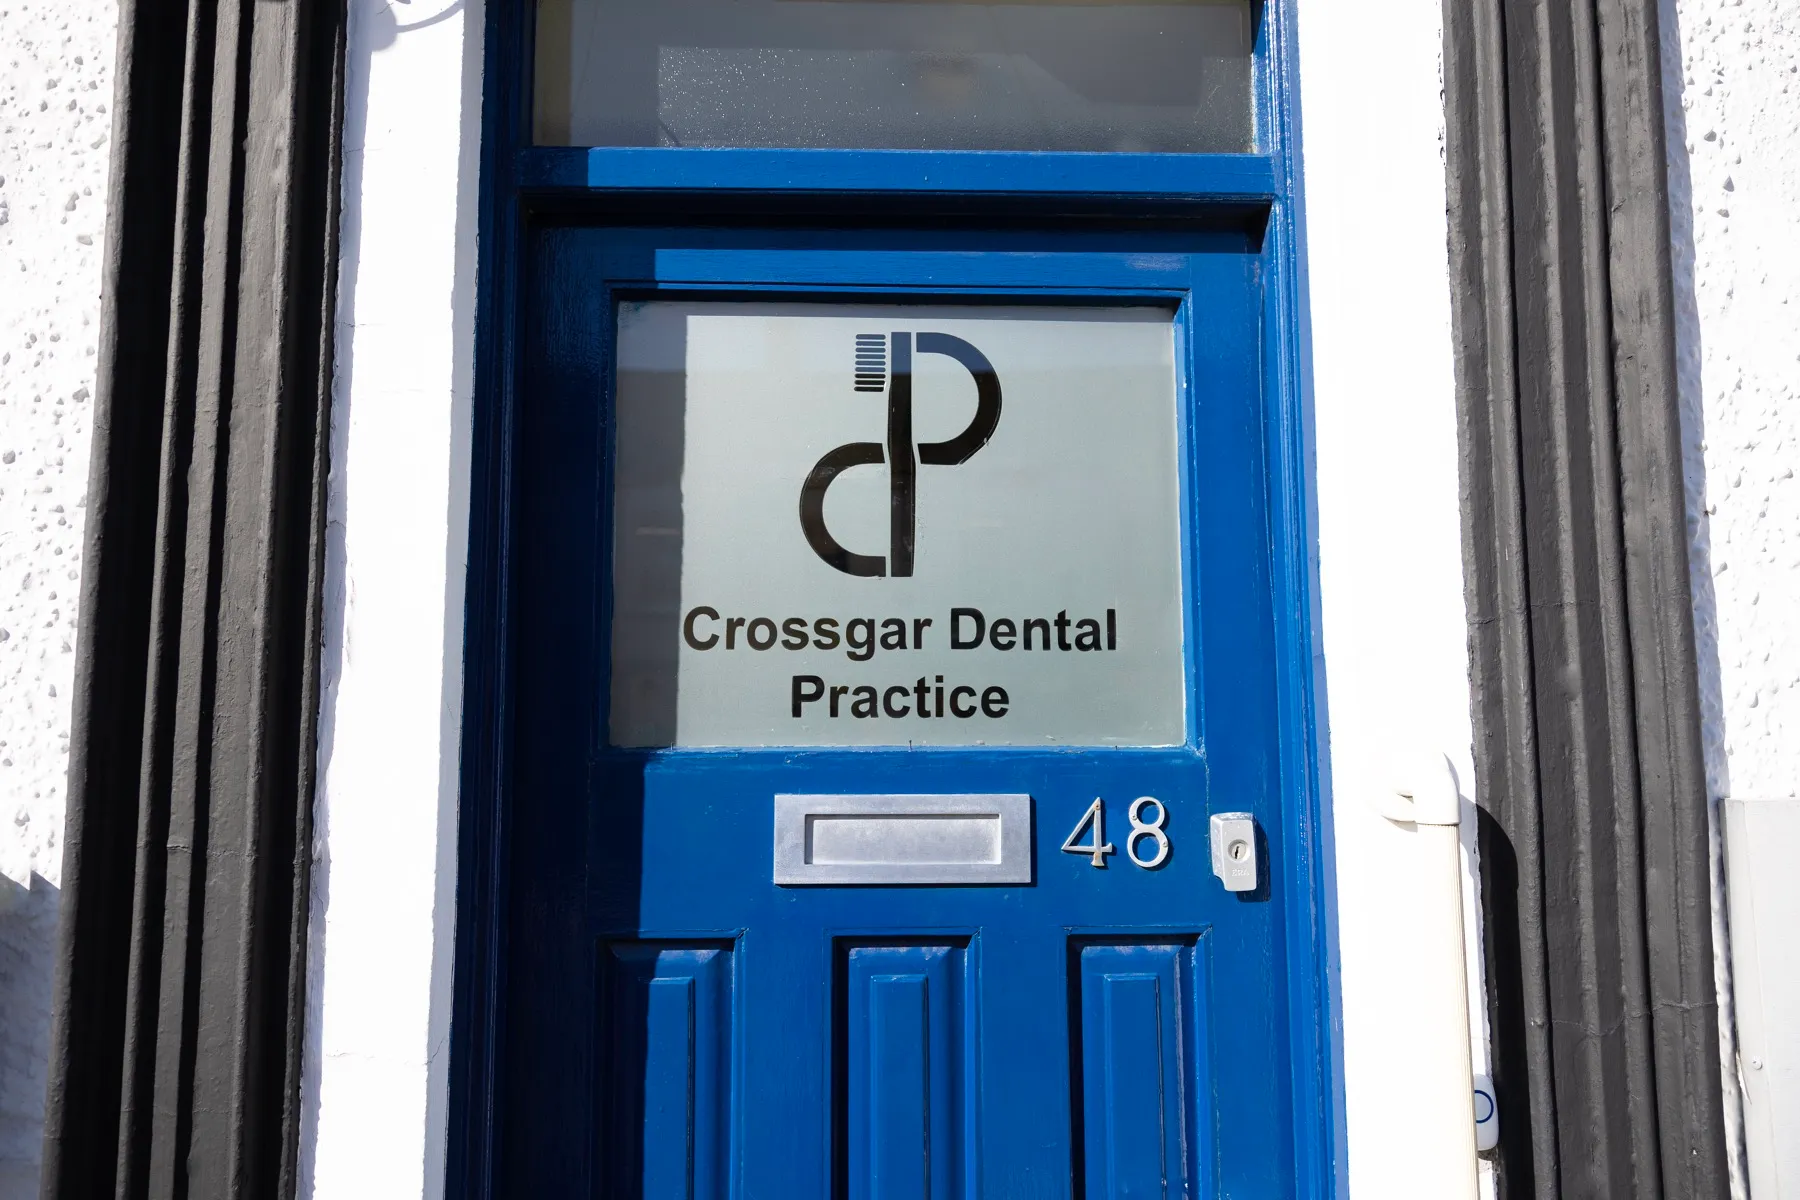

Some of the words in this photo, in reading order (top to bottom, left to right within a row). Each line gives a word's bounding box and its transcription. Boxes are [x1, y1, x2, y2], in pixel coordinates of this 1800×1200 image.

[683, 605, 933, 662] Crossgar
[951, 607, 1117, 652] Dental
[791, 674, 1010, 719] Practice
[1060, 796, 1169, 868] 48
